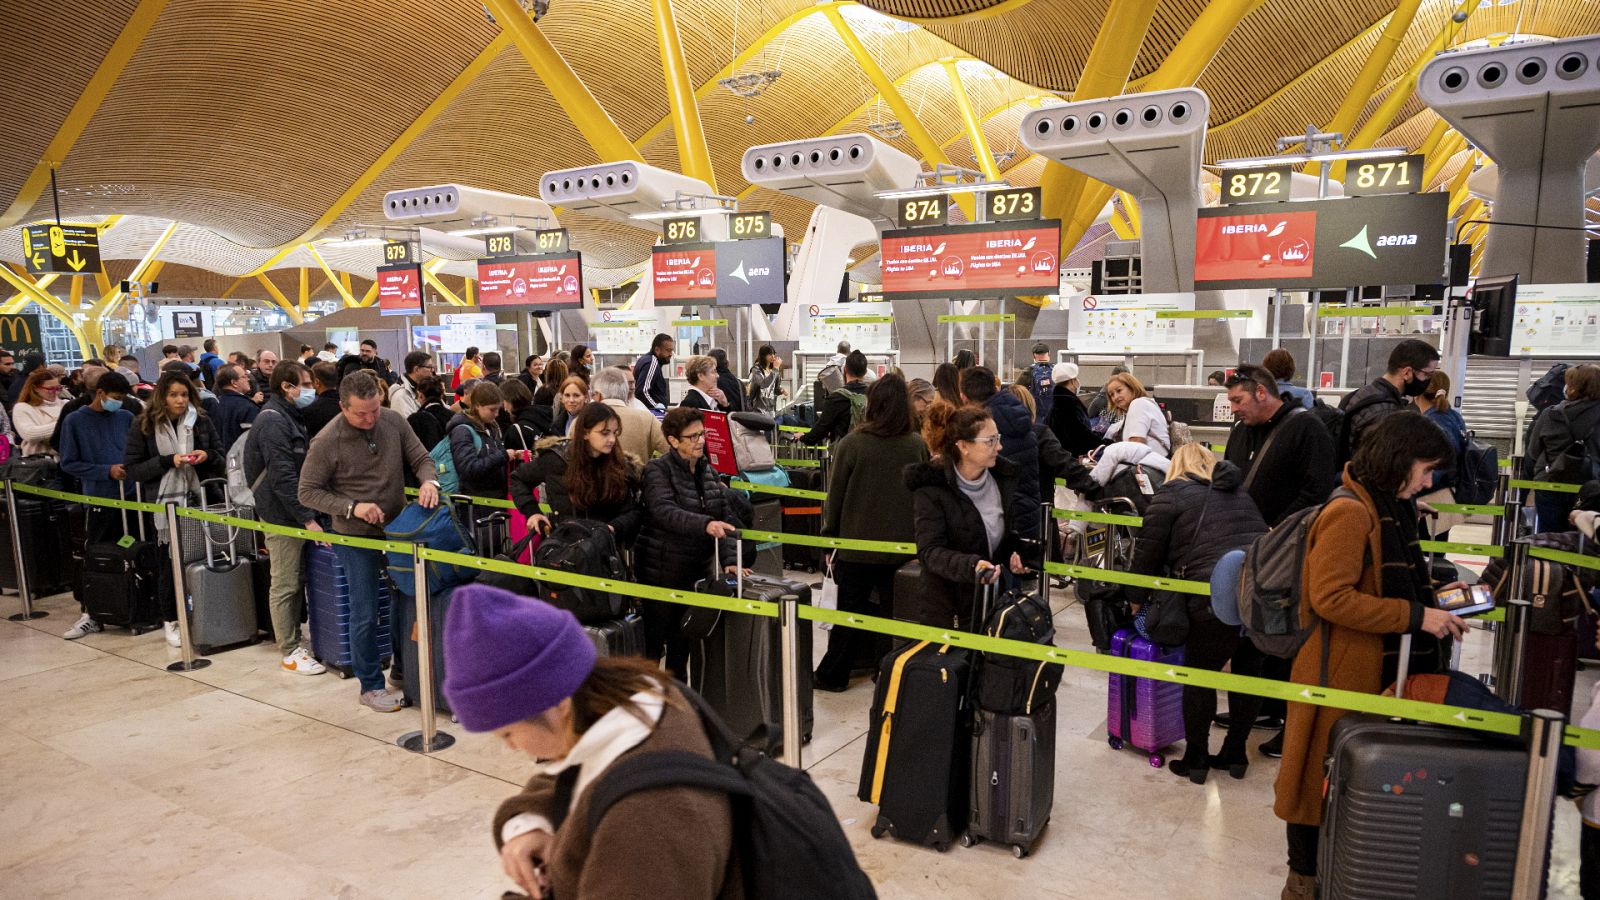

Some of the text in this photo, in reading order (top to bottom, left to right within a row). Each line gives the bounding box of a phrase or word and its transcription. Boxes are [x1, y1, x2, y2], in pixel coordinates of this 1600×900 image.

[1356, 160, 1410, 188] 871
[1229, 171, 1281, 197] 872
[904, 199, 941, 221] 874
[992, 192, 1034, 215] 873
[668, 221, 696, 239] 876
[734, 215, 764, 234] 875
[1221, 223, 1268, 235] IBERIA
[489, 236, 511, 253] 878
[539, 232, 563, 249] 877
[900, 243, 933, 253] IBERIA
[985, 238, 1022, 248] IBERIA
[1376, 232, 1418, 247] aena
[386, 245, 405, 260] 879
[666, 258, 691, 266] IBERIA
[748, 266, 770, 277] aena
